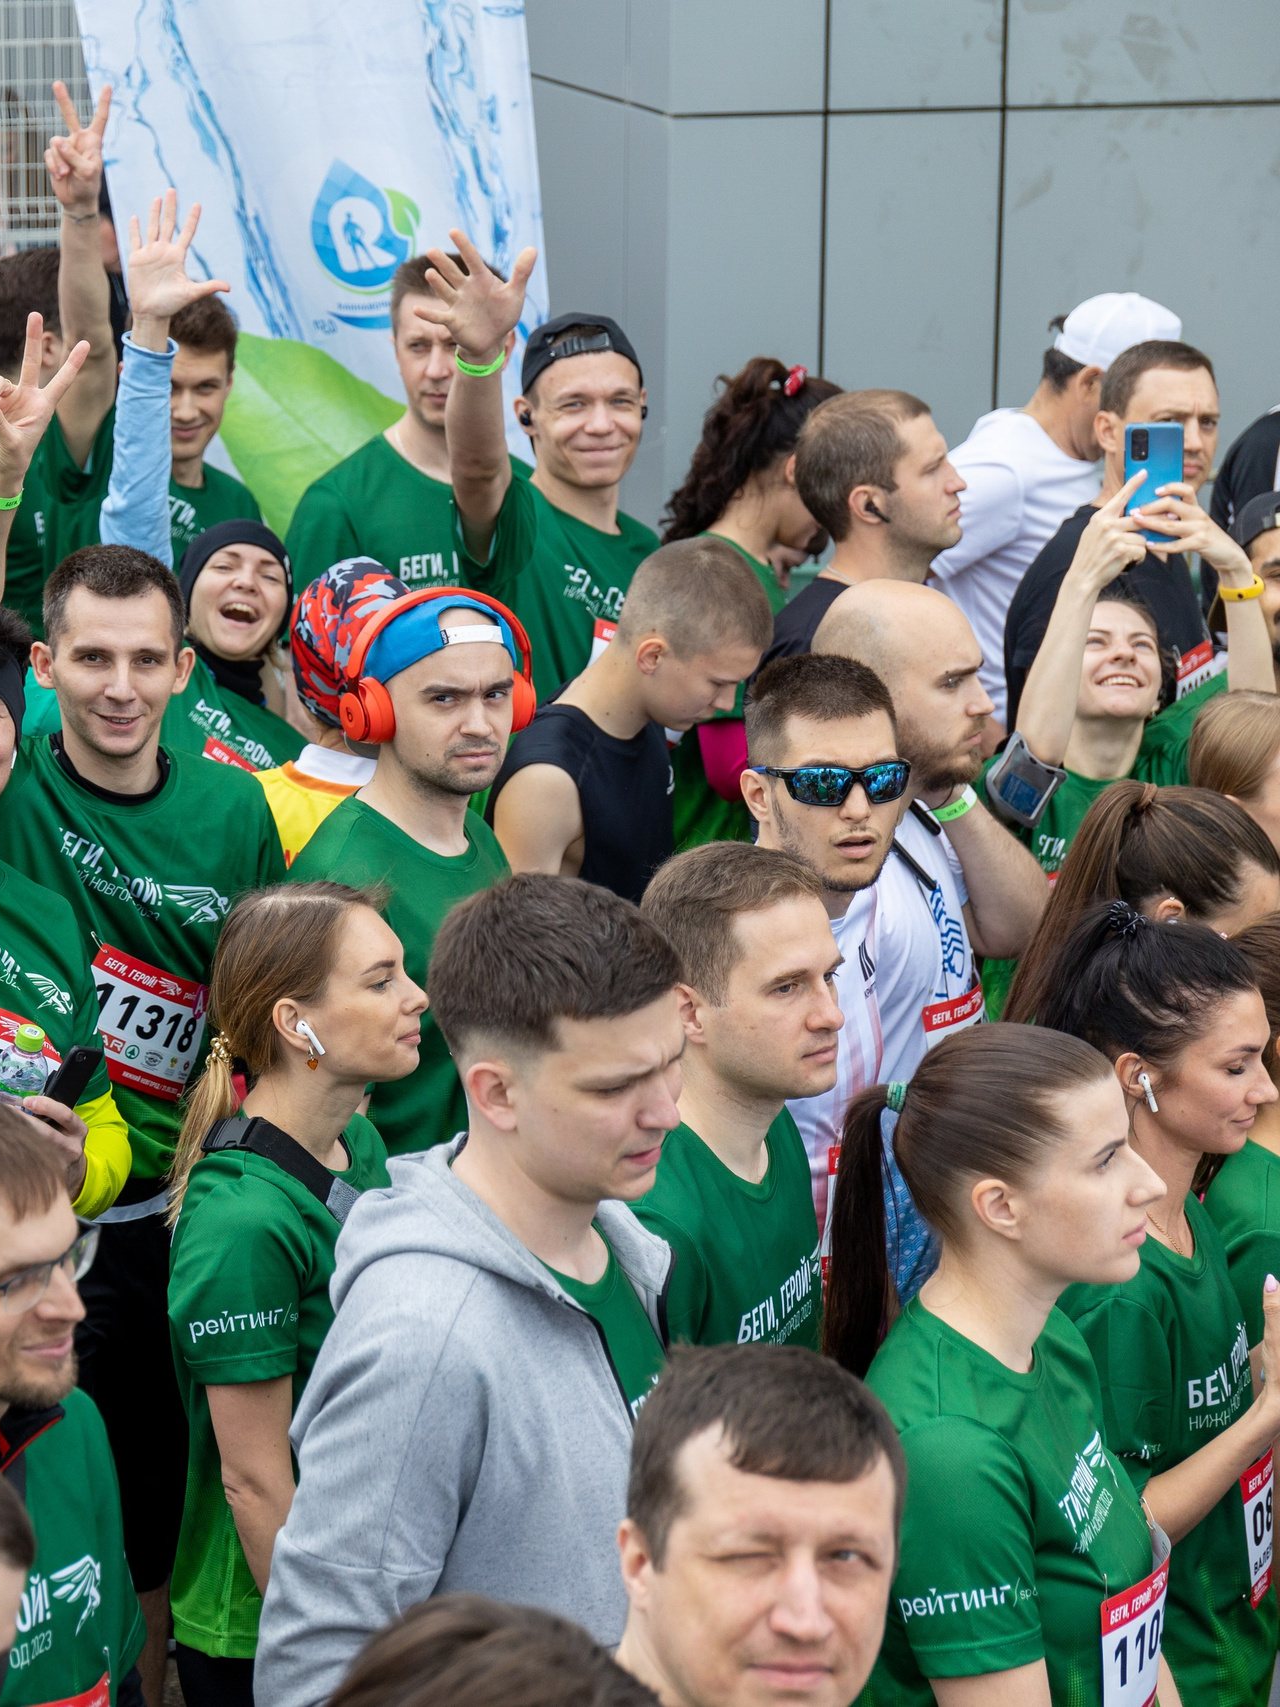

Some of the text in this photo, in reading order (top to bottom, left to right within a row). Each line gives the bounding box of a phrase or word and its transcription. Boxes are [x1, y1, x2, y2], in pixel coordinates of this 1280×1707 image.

[399, 552, 449, 581] БЕГИ,
[59, 827, 104, 875] ЕГИ,
[104, 957, 127, 977] БЕГИ,
[128, 969, 158, 988] ГЕРОЙ!
[96, 982, 198, 1053] 11318
[932, 1009, 953, 1026] БЕГИ,
[737, 1256, 811, 1345] БЕГИ, ГЕРОЙ!
[1189, 1410, 1231, 1431] НИЖН
[1110, 1587, 1152, 1626] БЕГИ, ГЕРОЙ!
[31, 1629, 52, 1660] 2023
[1114, 1603, 1166, 1689] 110
